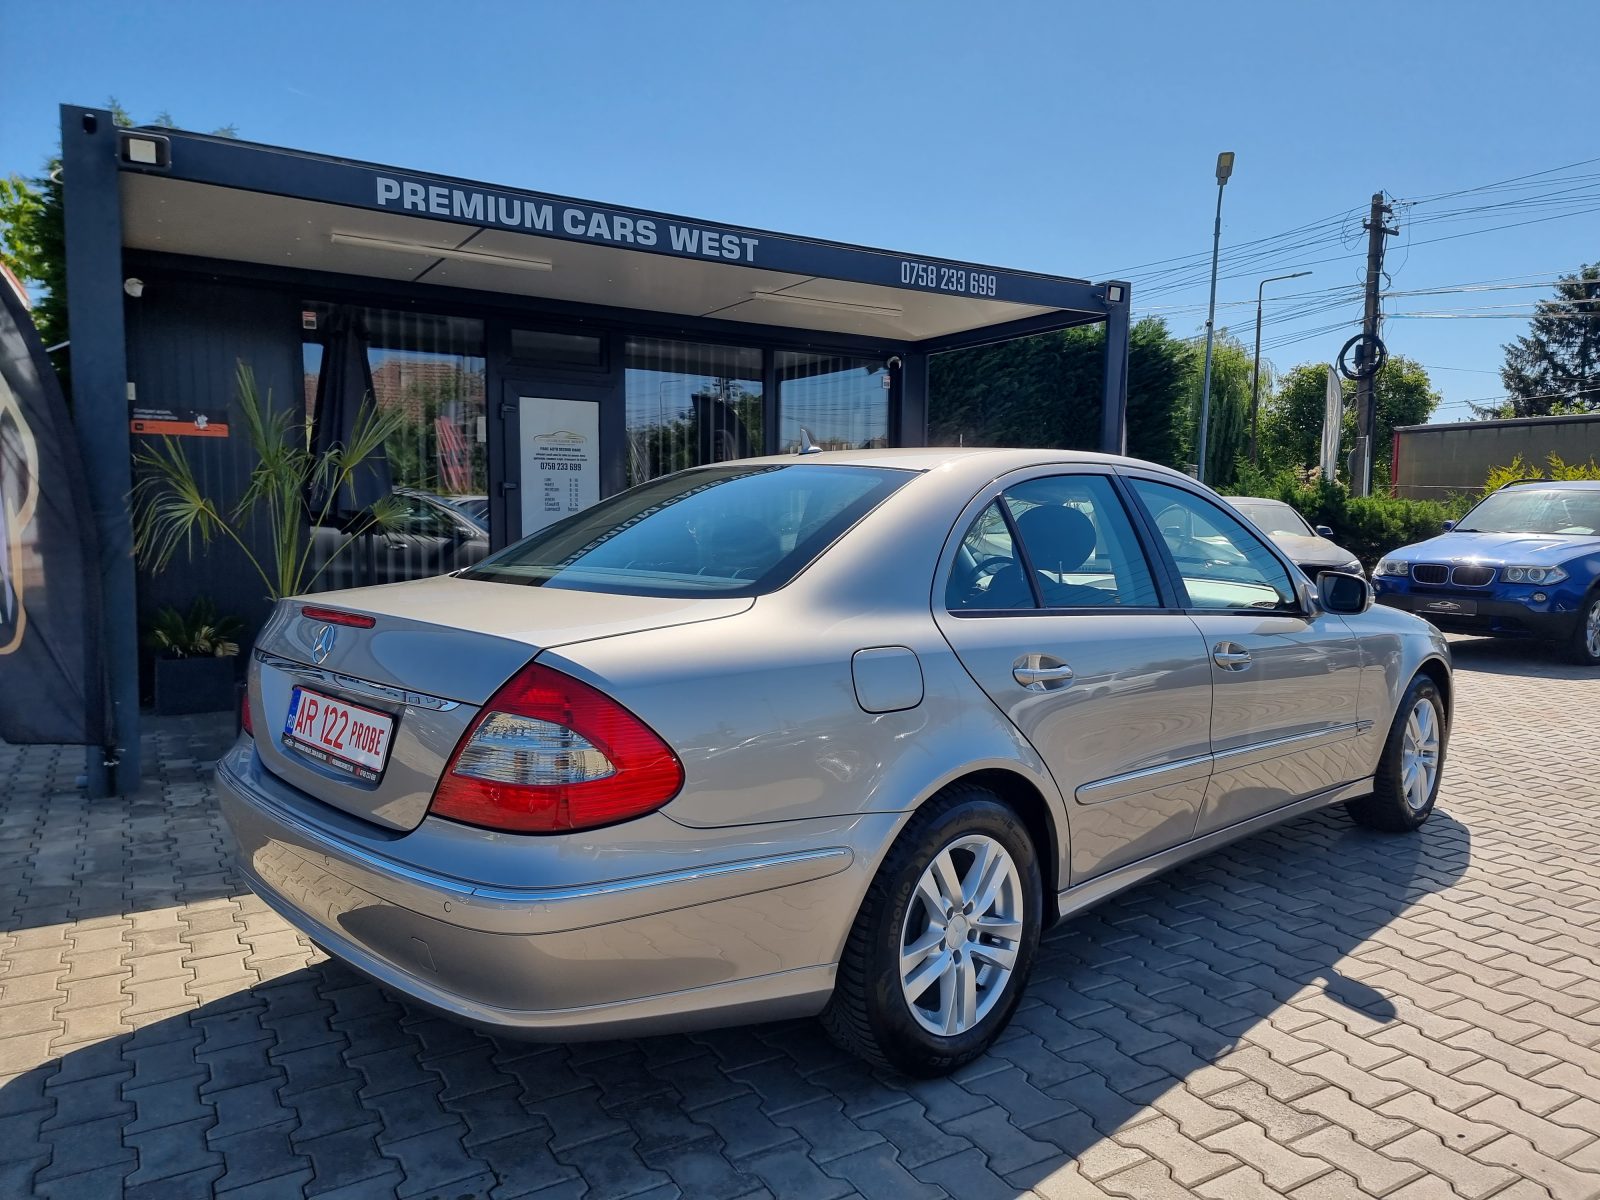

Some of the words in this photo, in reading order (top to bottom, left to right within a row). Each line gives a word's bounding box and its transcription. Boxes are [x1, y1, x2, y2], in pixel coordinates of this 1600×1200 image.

[376, 176, 553, 232] PREMIUM
[563, 208, 658, 247] CARS
[669, 225, 759, 263] WEST
[901, 261, 937, 288] 0758
[940, 267, 967, 292] 233
[969, 272, 997, 297] 699
[540, 461, 556, 471] 0758
[556, 462, 569, 471] 233
[569, 463, 582, 472] 699
[294, 696, 319, 738] AR
[319, 704, 349, 750] 122
[348, 720, 385, 756] PROBE
